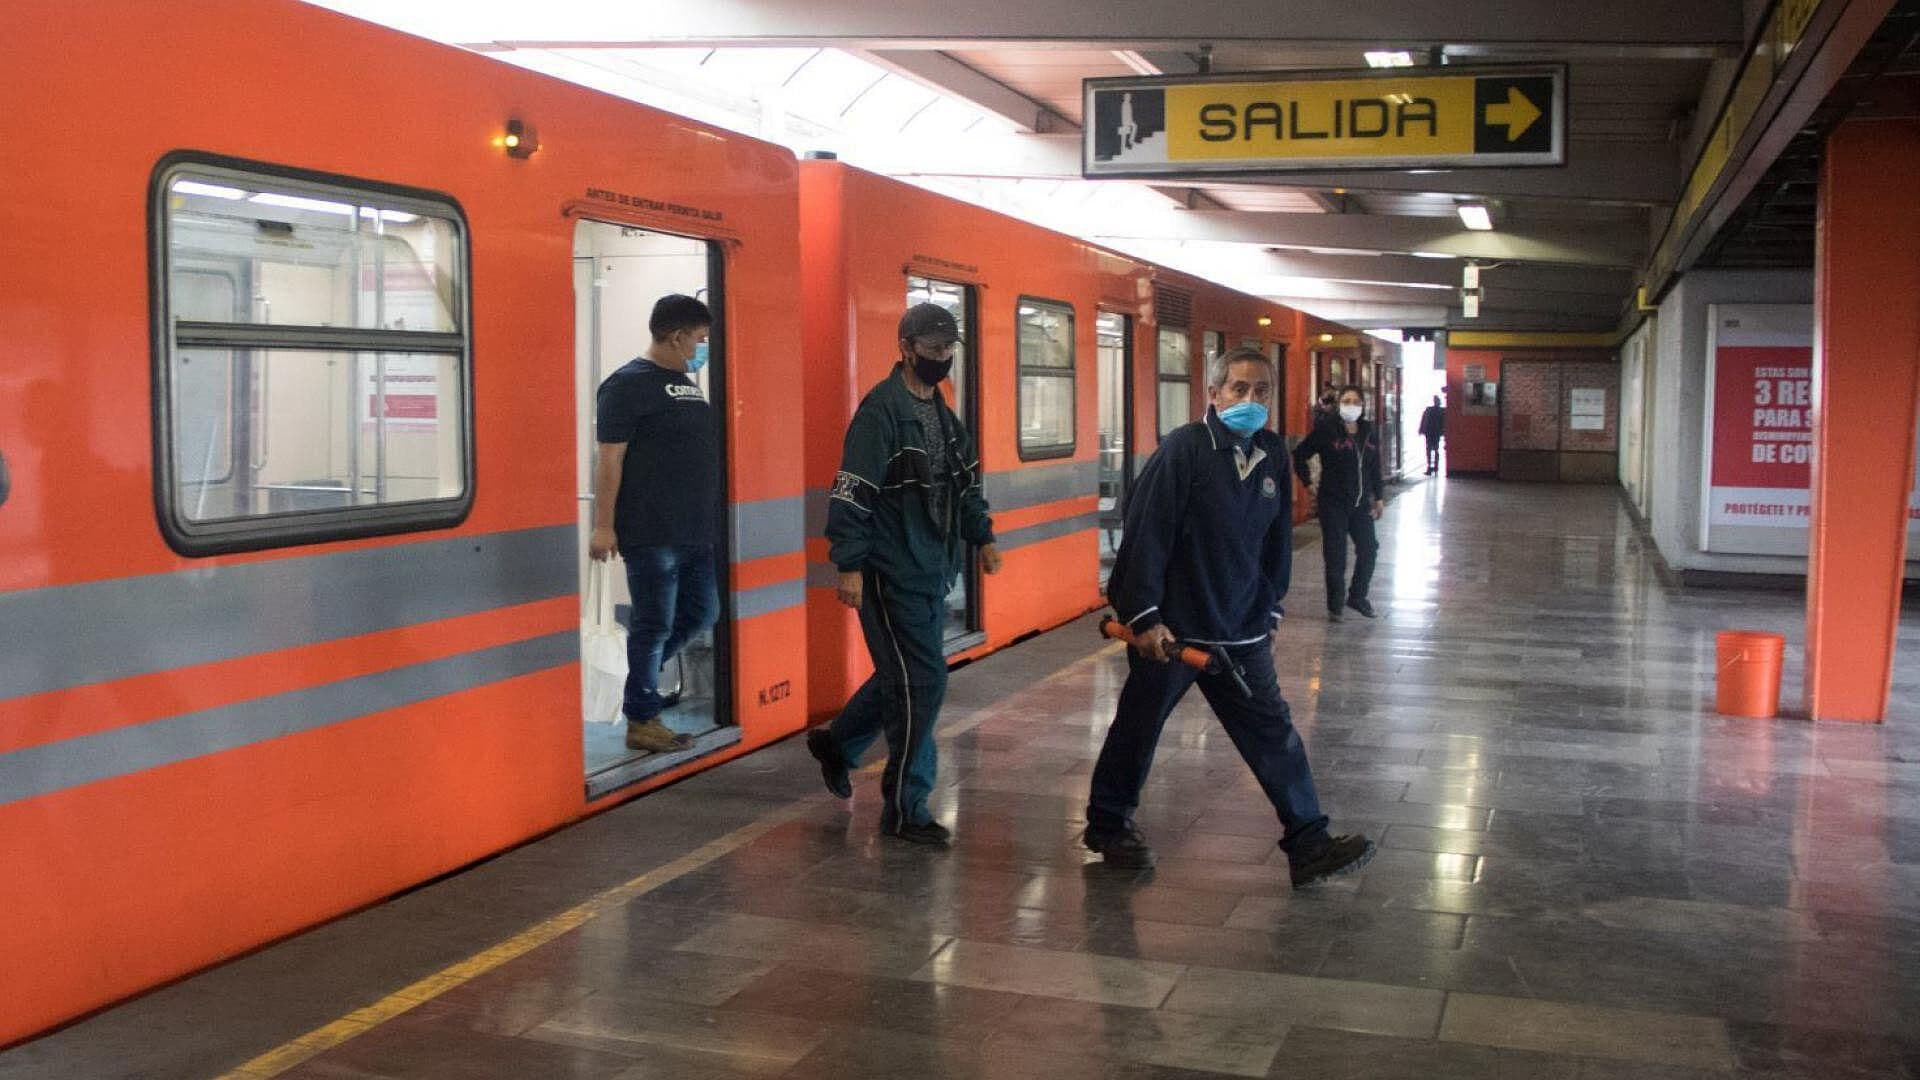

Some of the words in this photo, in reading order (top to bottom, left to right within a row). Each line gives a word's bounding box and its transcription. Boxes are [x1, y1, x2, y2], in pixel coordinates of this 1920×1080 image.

[1199, 98, 1437, 142] SALIDA
[586, 187, 615, 201] ANTES
[618, 193, 630, 205] DE
[1754, 380, 1772, 405] 3
[1777, 380, 1813, 405] RE
[1753, 409, 1801, 428] PARA
[1752, 444, 1777, 463] DE
[1723, 501, 1784, 516] PROTÉGETE
[1787, 505, 1794, 516] Y
